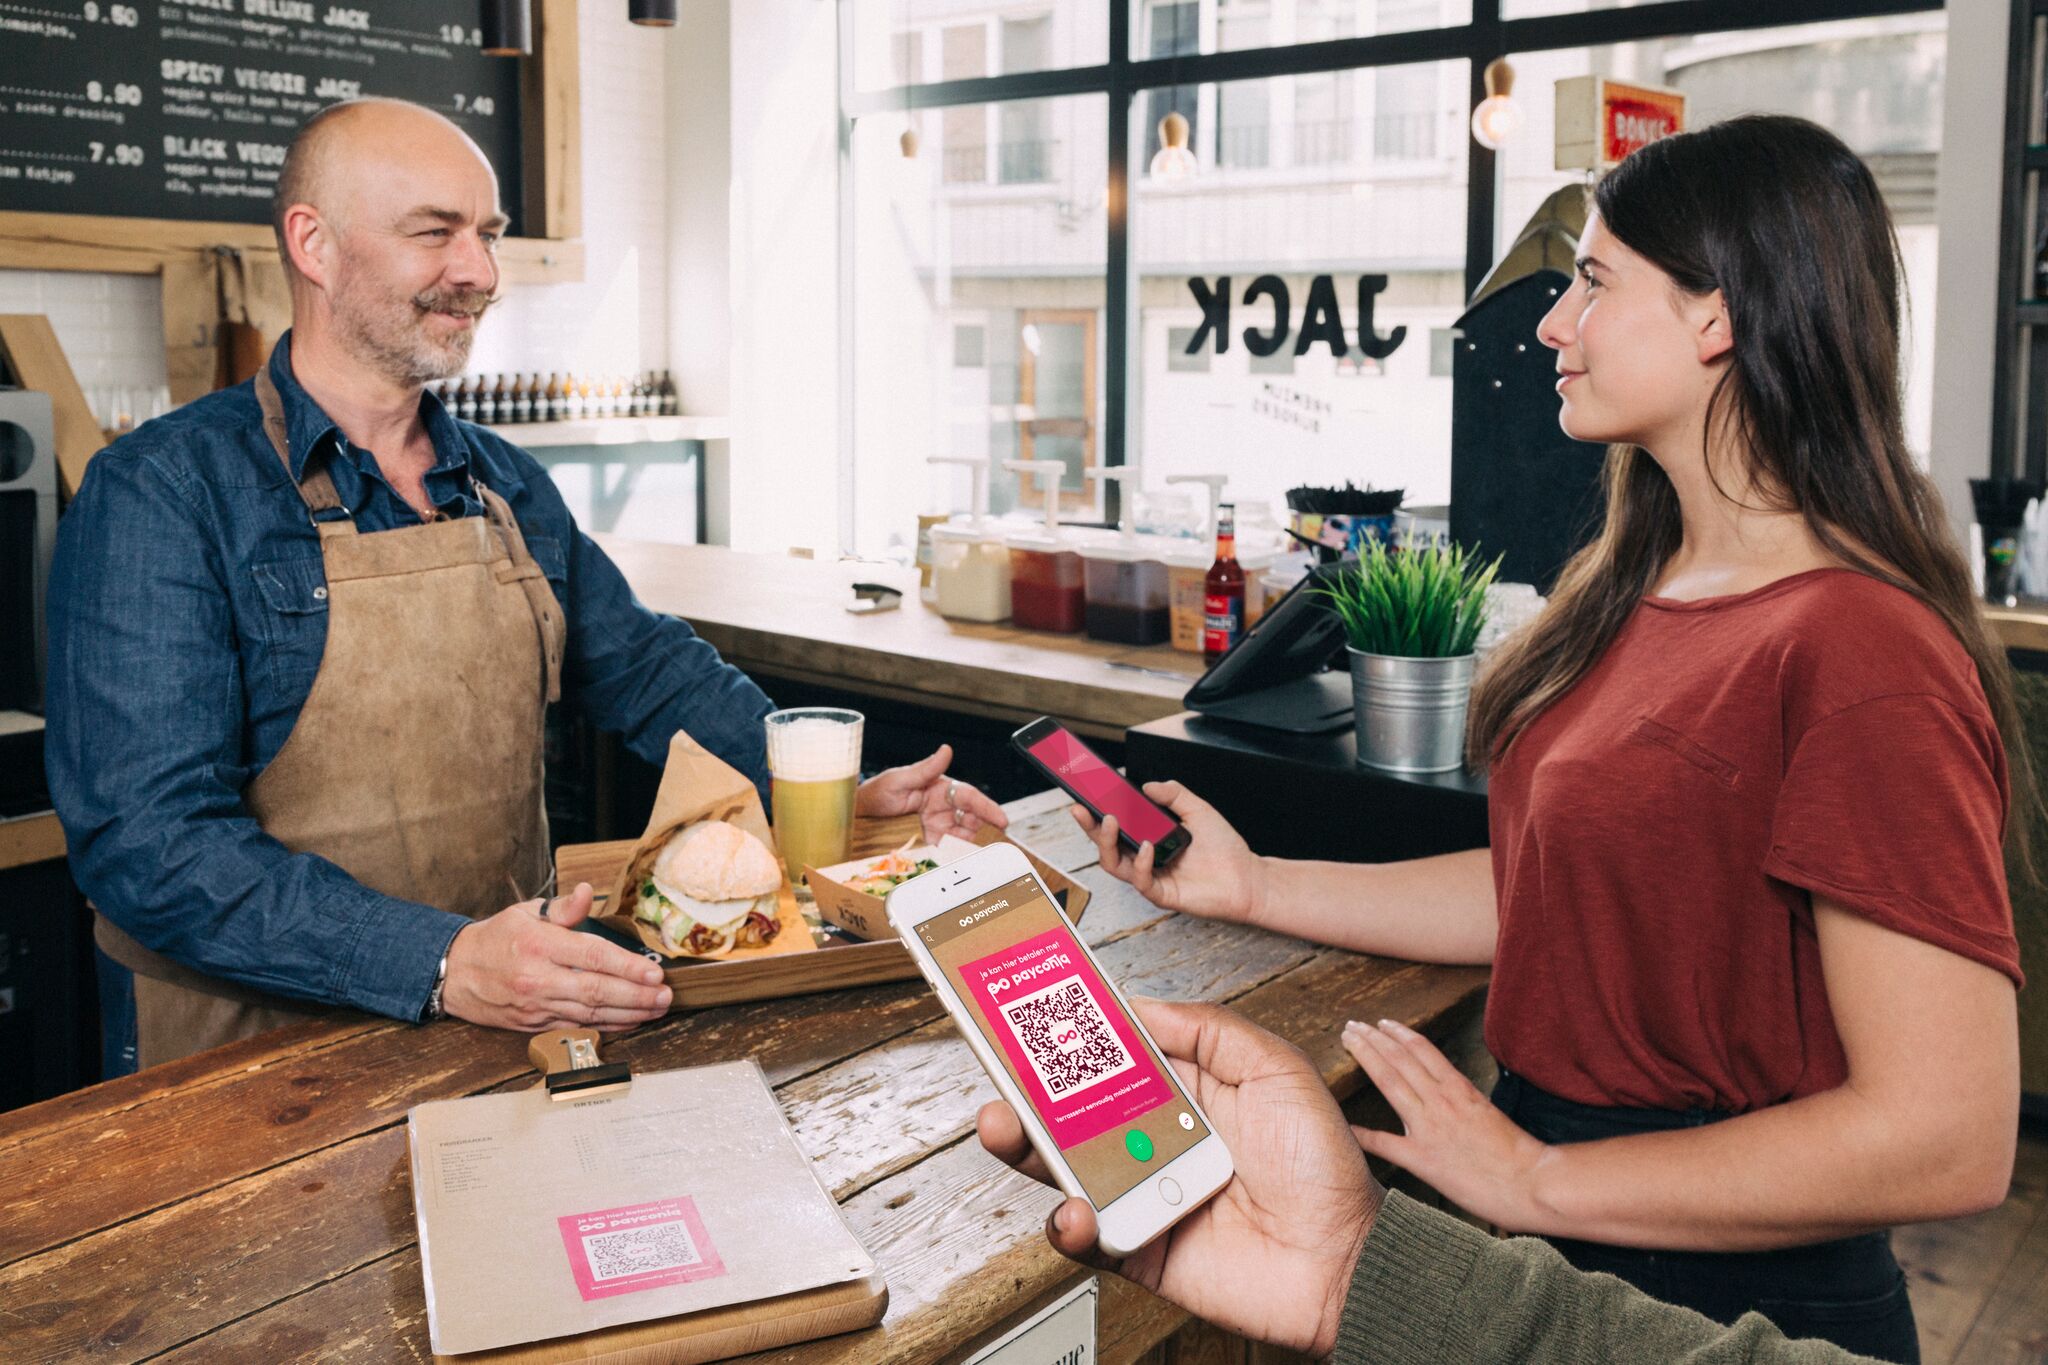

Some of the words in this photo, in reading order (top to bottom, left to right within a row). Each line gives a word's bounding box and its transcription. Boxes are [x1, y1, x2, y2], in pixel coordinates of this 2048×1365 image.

[323, 6, 370, 31] JACK
[161, 59, 224, 85] SPICY
[234, 67, 306, 95] VEGGIE
[314, 77, 361, 100] JACK
[89, 142, 144, 166] 7.90
[163, 135, 227, 160] BLACK
[236, 141, 288, 166] VEGG
[987, 965, 1003, 976] kan
[1002, 959, 1017, 970] hier
[1017, 948, 1046, 964] betalen
[1045, 941, 1060, 952] met
[1113, 1085, 1132, 1098] mobiel
[1131, 1076, 1151, 1090] betalen
